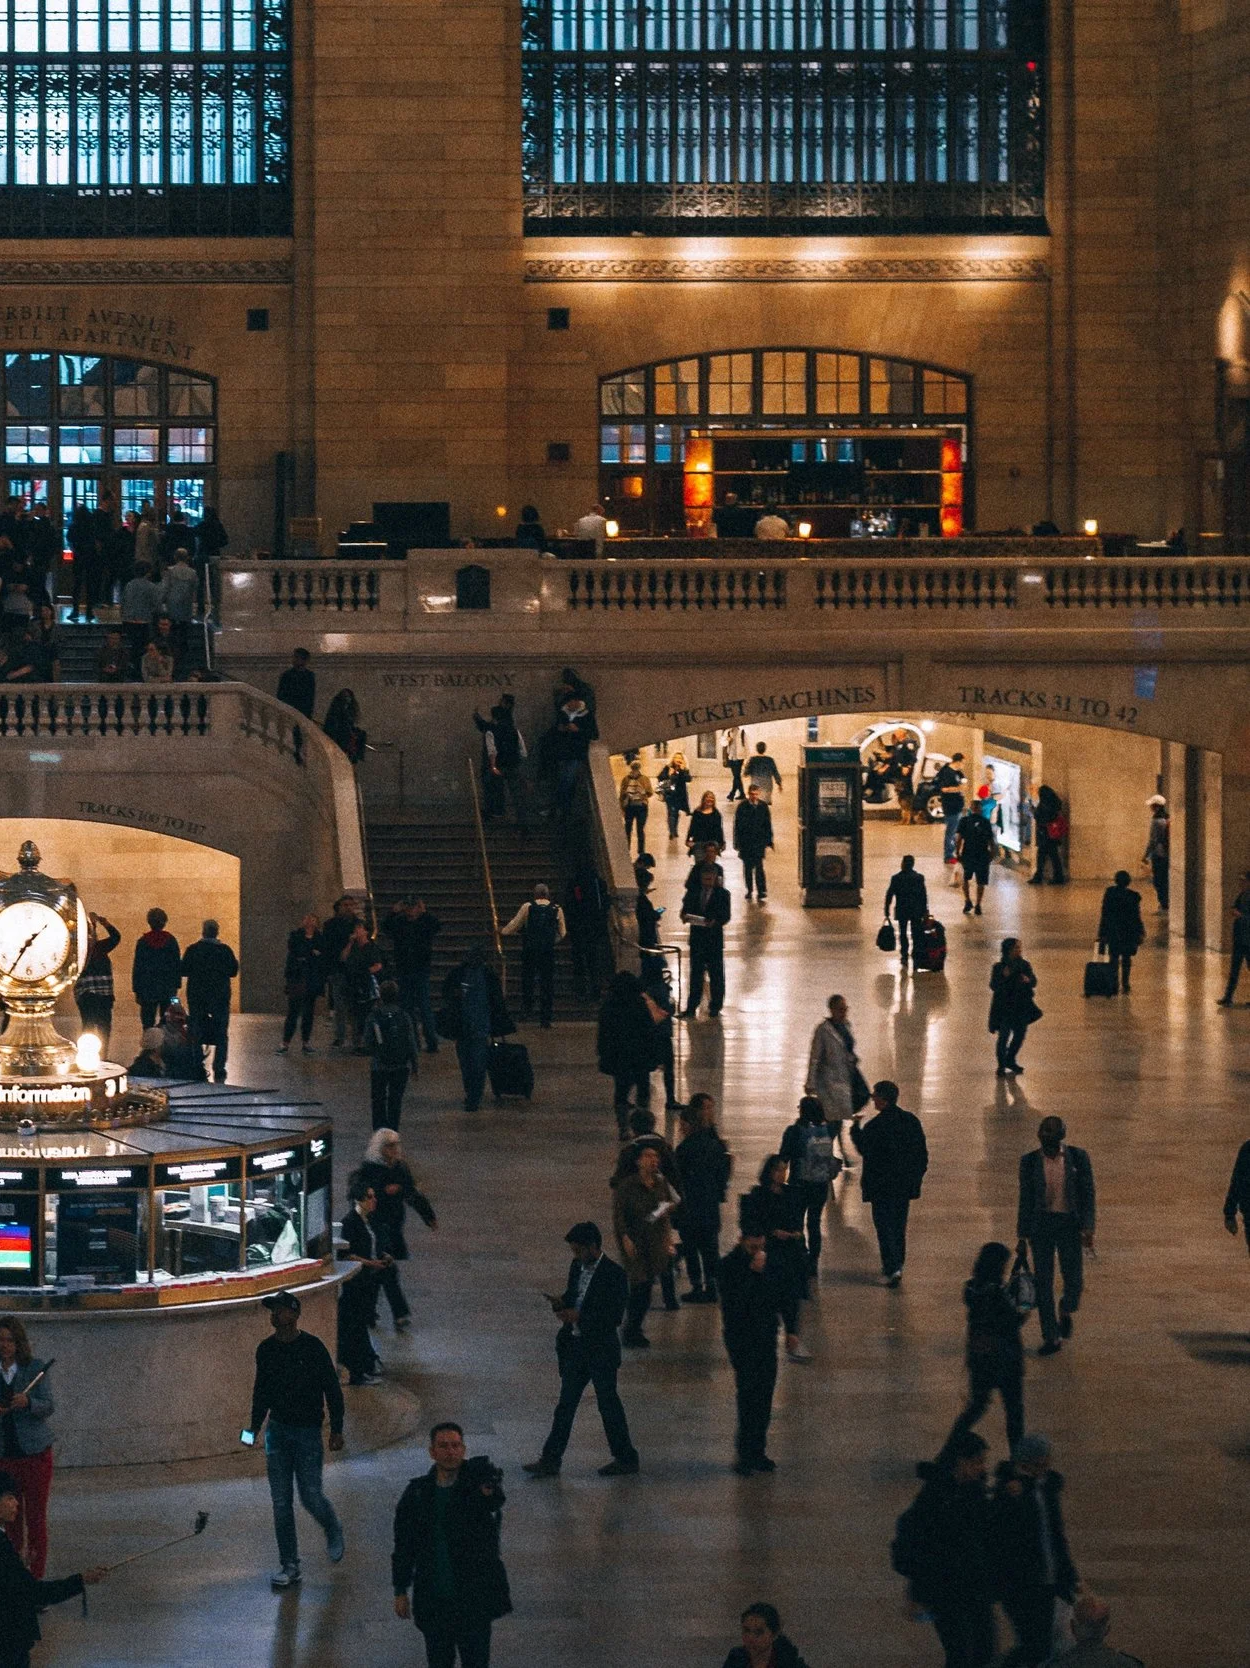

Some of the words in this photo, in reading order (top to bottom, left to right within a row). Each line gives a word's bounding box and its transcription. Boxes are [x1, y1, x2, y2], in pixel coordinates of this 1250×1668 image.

[88, 307, 177, 336] AVENUE
[55, 326, 195, 360] APARTMENT
[383, 673, 430, 687] WEST
[434, 673, 516, 687] BALCONY
[668, 699, 748, 729] TICKET
[757, 686, 877, 714] MACHINES
[958, 686, 1047, 710] TRACKS
[1051, 694, 1073, 712] 31
[1080, 697, 1111, 719] TO
[1115, 706, 1139, 724] 42
[76, 801, 136, 819] TRACKS
[162, 815, 185, 830] TO
